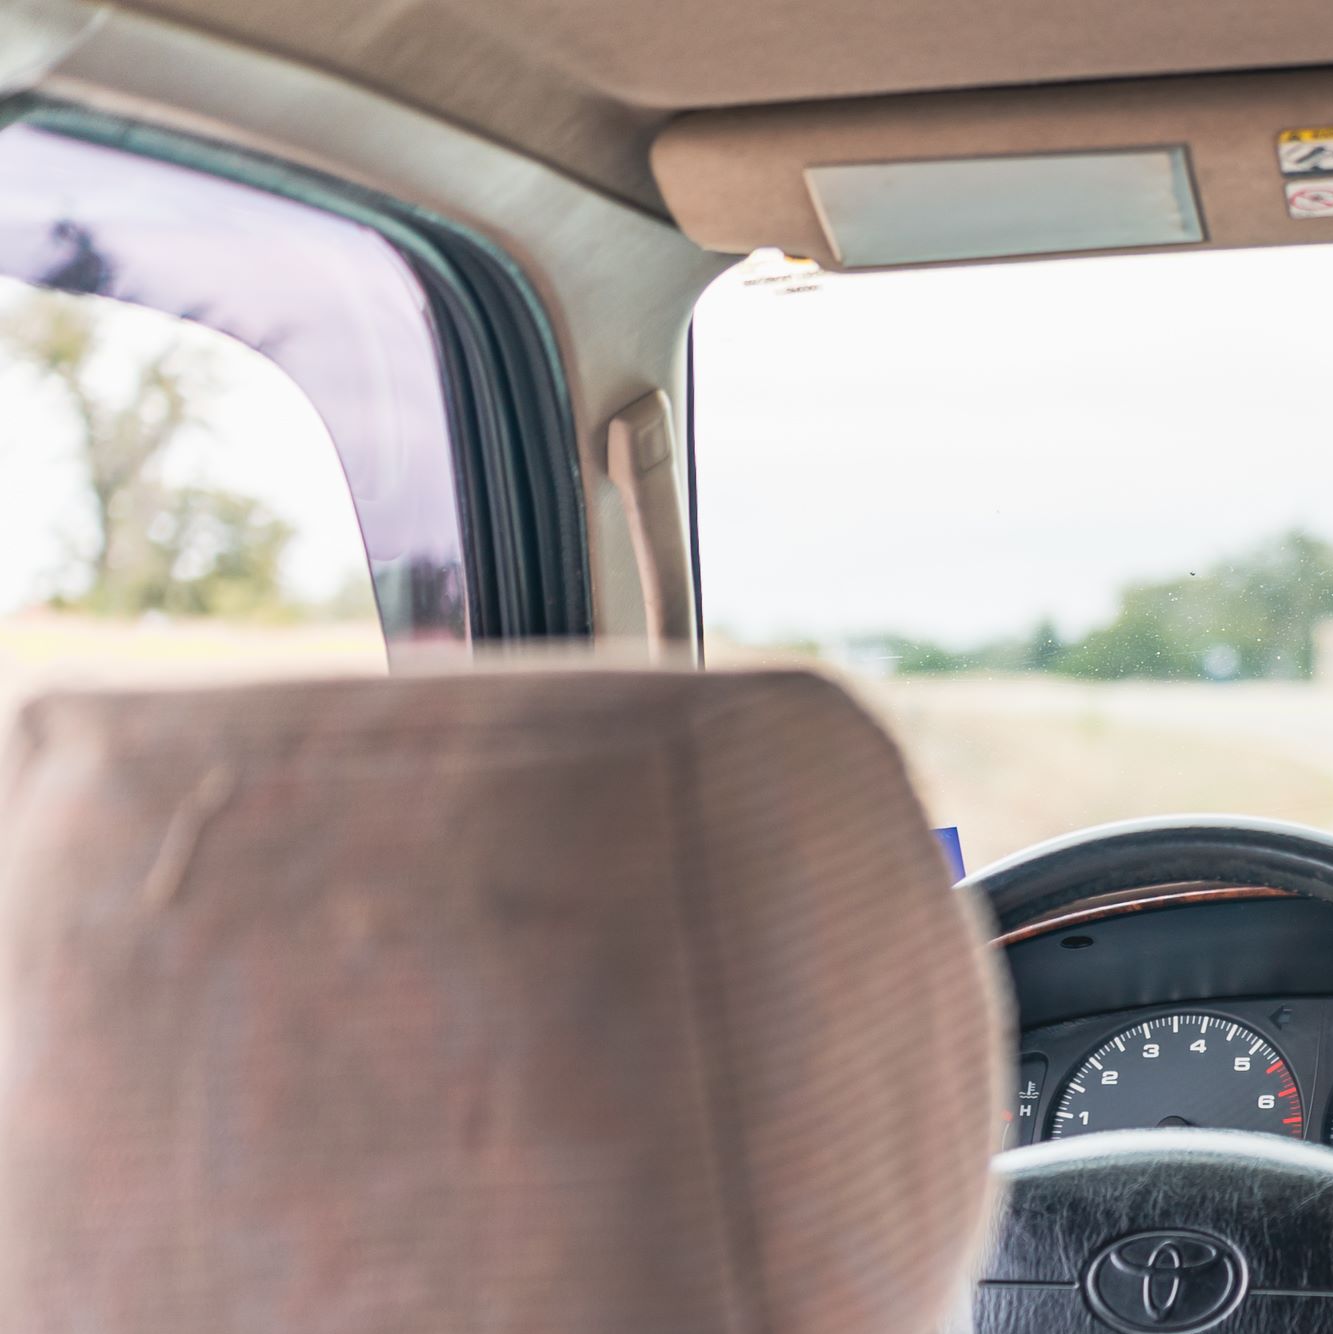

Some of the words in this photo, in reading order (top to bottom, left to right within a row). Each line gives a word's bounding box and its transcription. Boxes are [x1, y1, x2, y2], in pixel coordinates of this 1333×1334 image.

[1143, 1044, 1160, 1058] 3
[1190, 1040, 1207, 1053] 4
[1234, 1058, 1250, 1071] 5
[1101, 1071, 1118, 1085] 2
[1258, 1095, 1275, 1109] 6
[1019, 1105, 1031, 1116] H
[1078, 1111, 1090, 1125] 1
